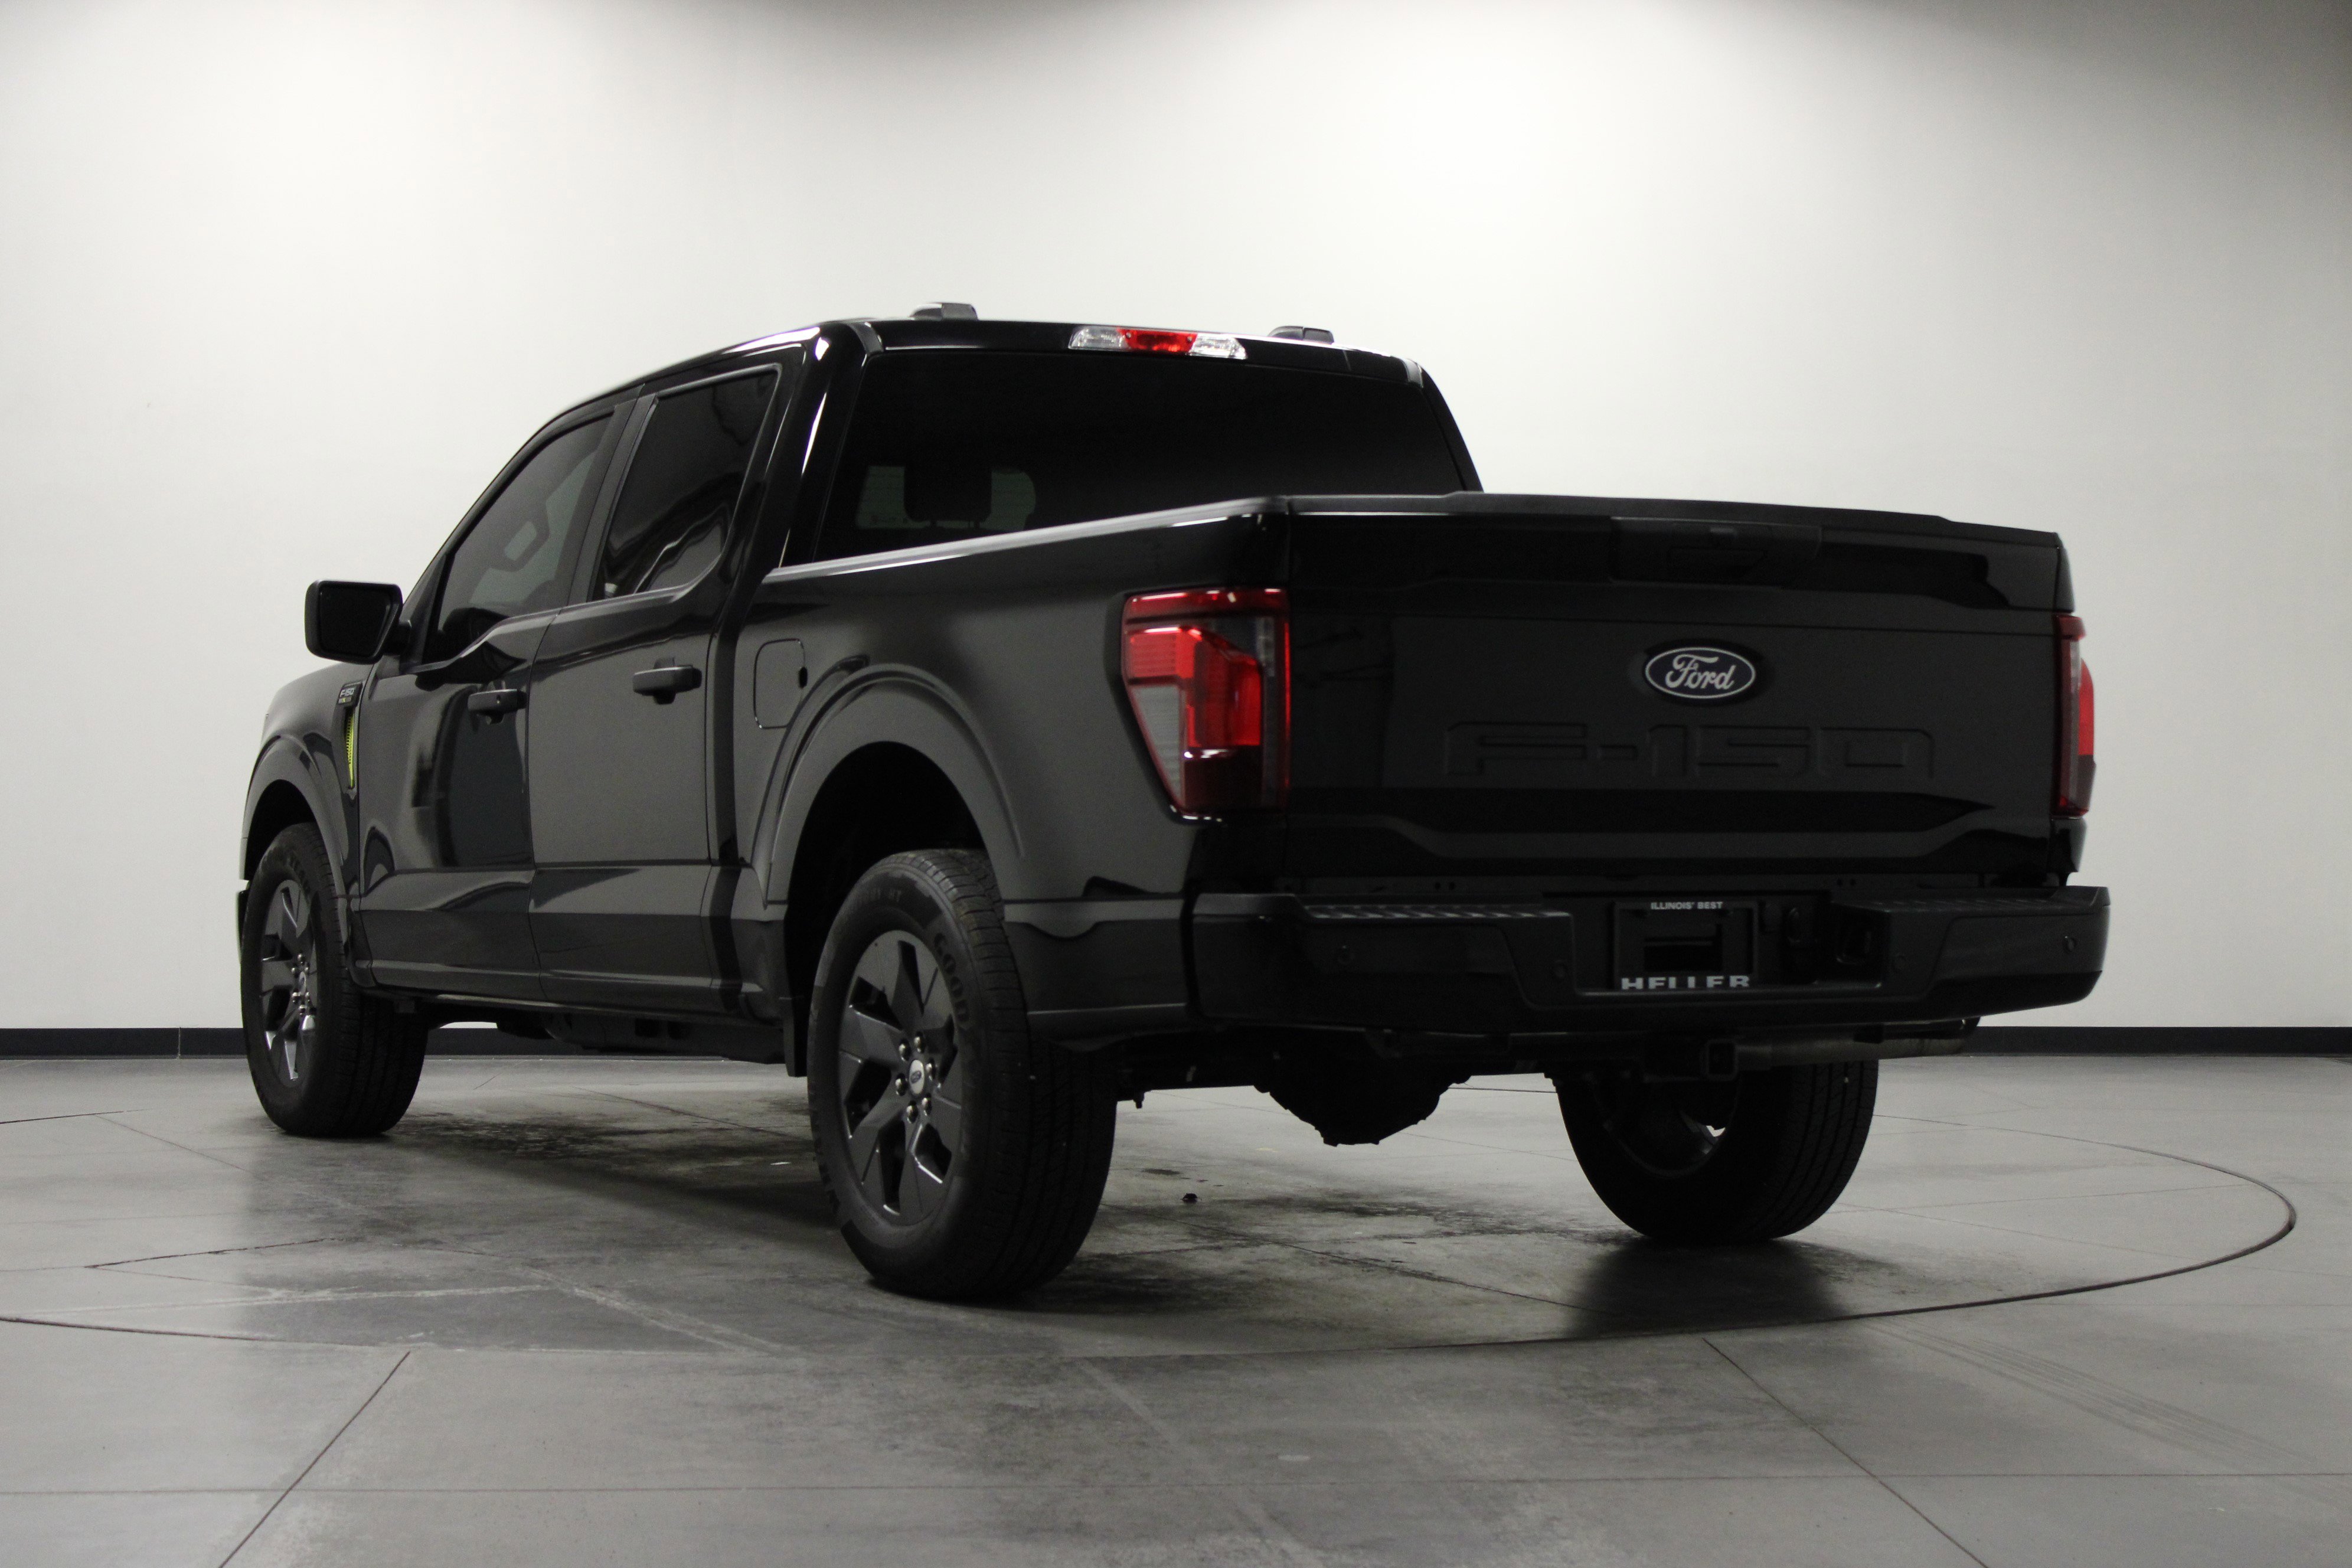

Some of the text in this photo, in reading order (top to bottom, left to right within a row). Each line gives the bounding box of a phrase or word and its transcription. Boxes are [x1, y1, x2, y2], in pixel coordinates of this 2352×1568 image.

[1665, 654, 1736, 690] Ford
[1446, 721, 1935, 778] F-150
[1697, 901, 1723, 910] BEST
